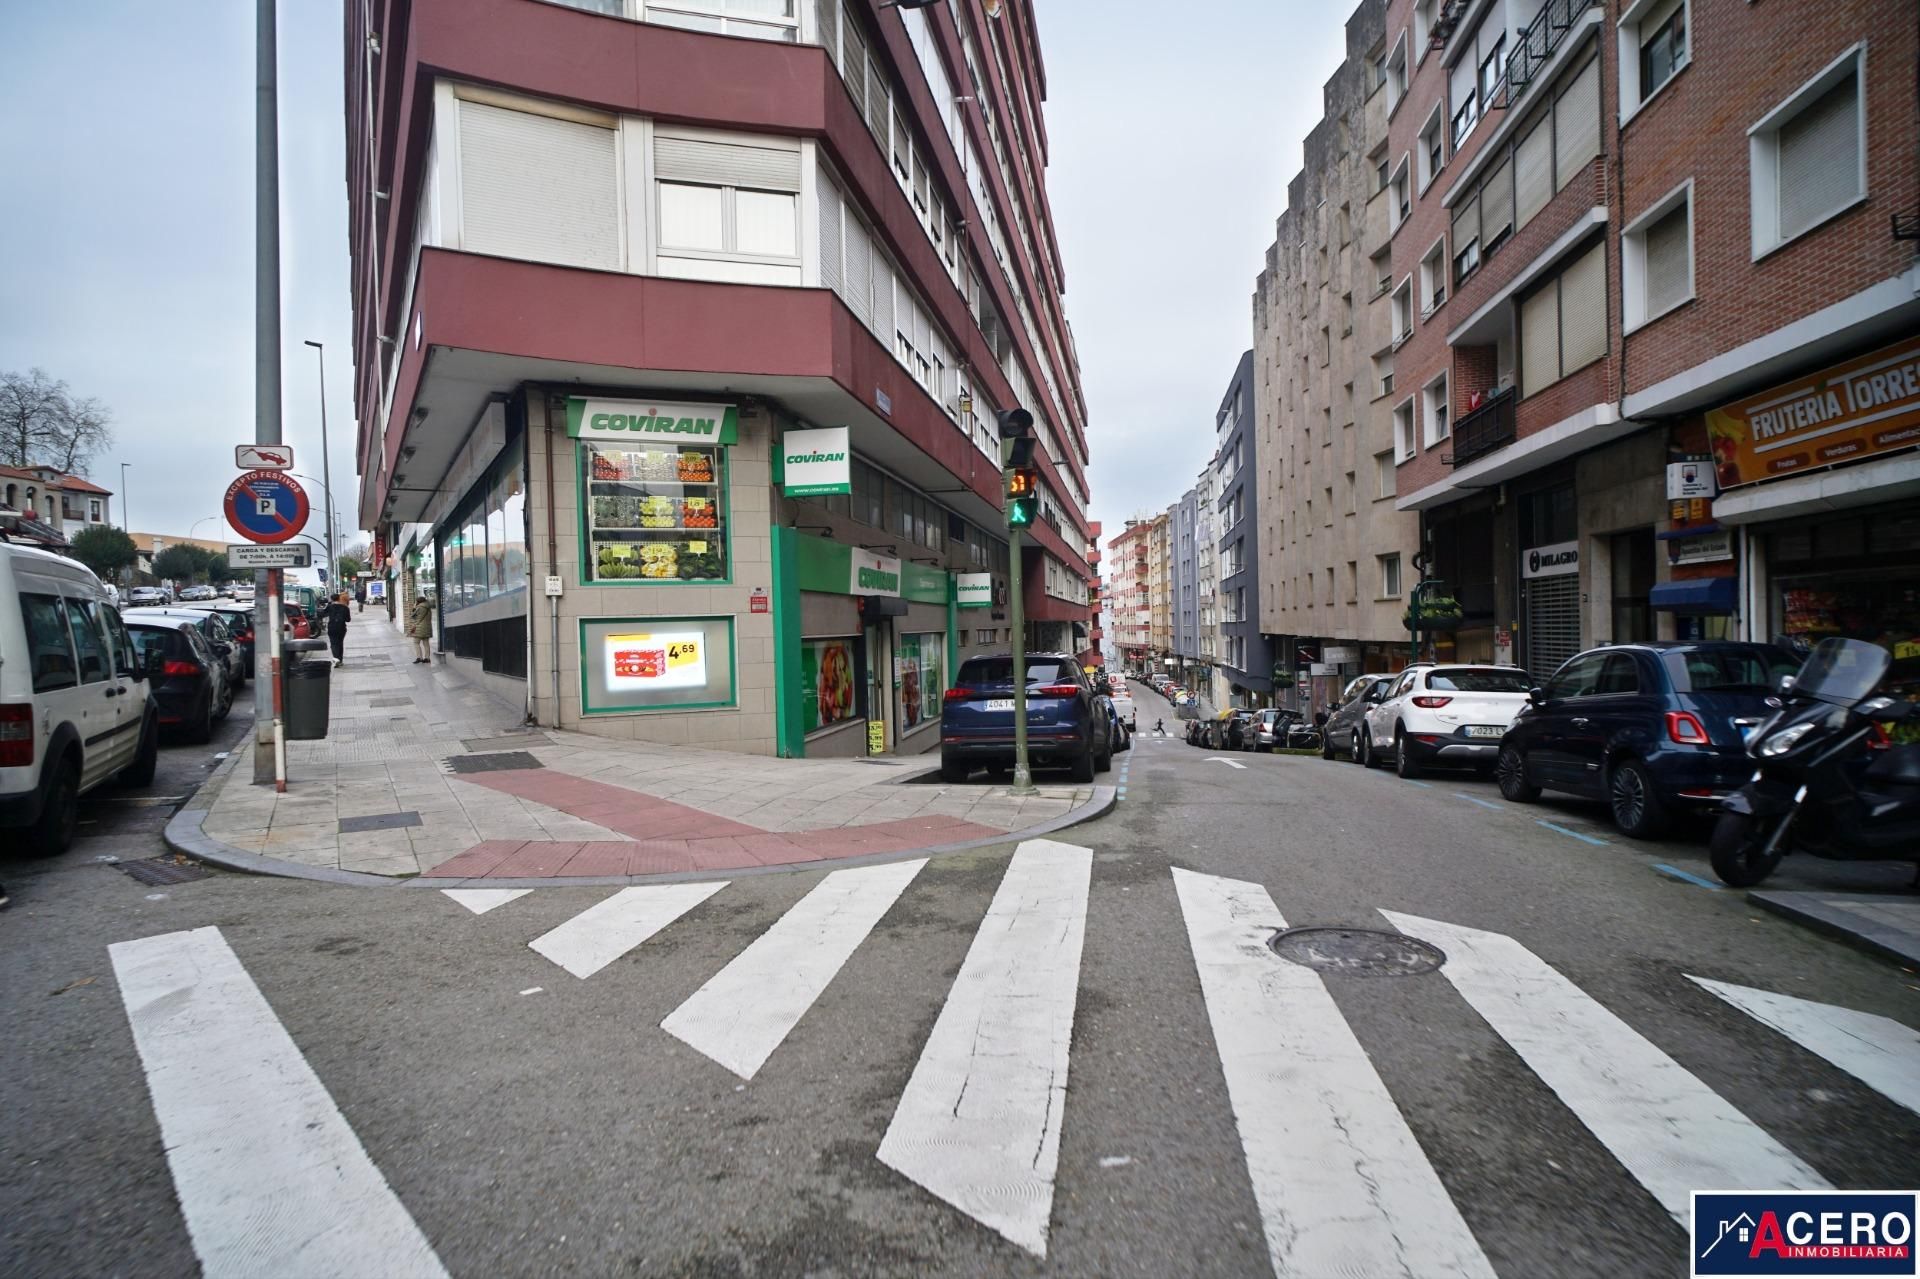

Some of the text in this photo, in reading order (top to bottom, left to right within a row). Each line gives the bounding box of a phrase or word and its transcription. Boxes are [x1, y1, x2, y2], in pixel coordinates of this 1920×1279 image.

[1750, 391, 1844, 441] FRUTERIA
[1825, 443, 1857, 457] Verduras
[1776, 458, 1797, 469] Frutas
[226, 472, 258, 500] EXCEPTO
[260, 471, 301, 493] FESTIVOS
[261, 500, 271, 513] P
[1541, 550, 1578, 567] MILAGRO
[1472, 727, 1493, 735] 7023
